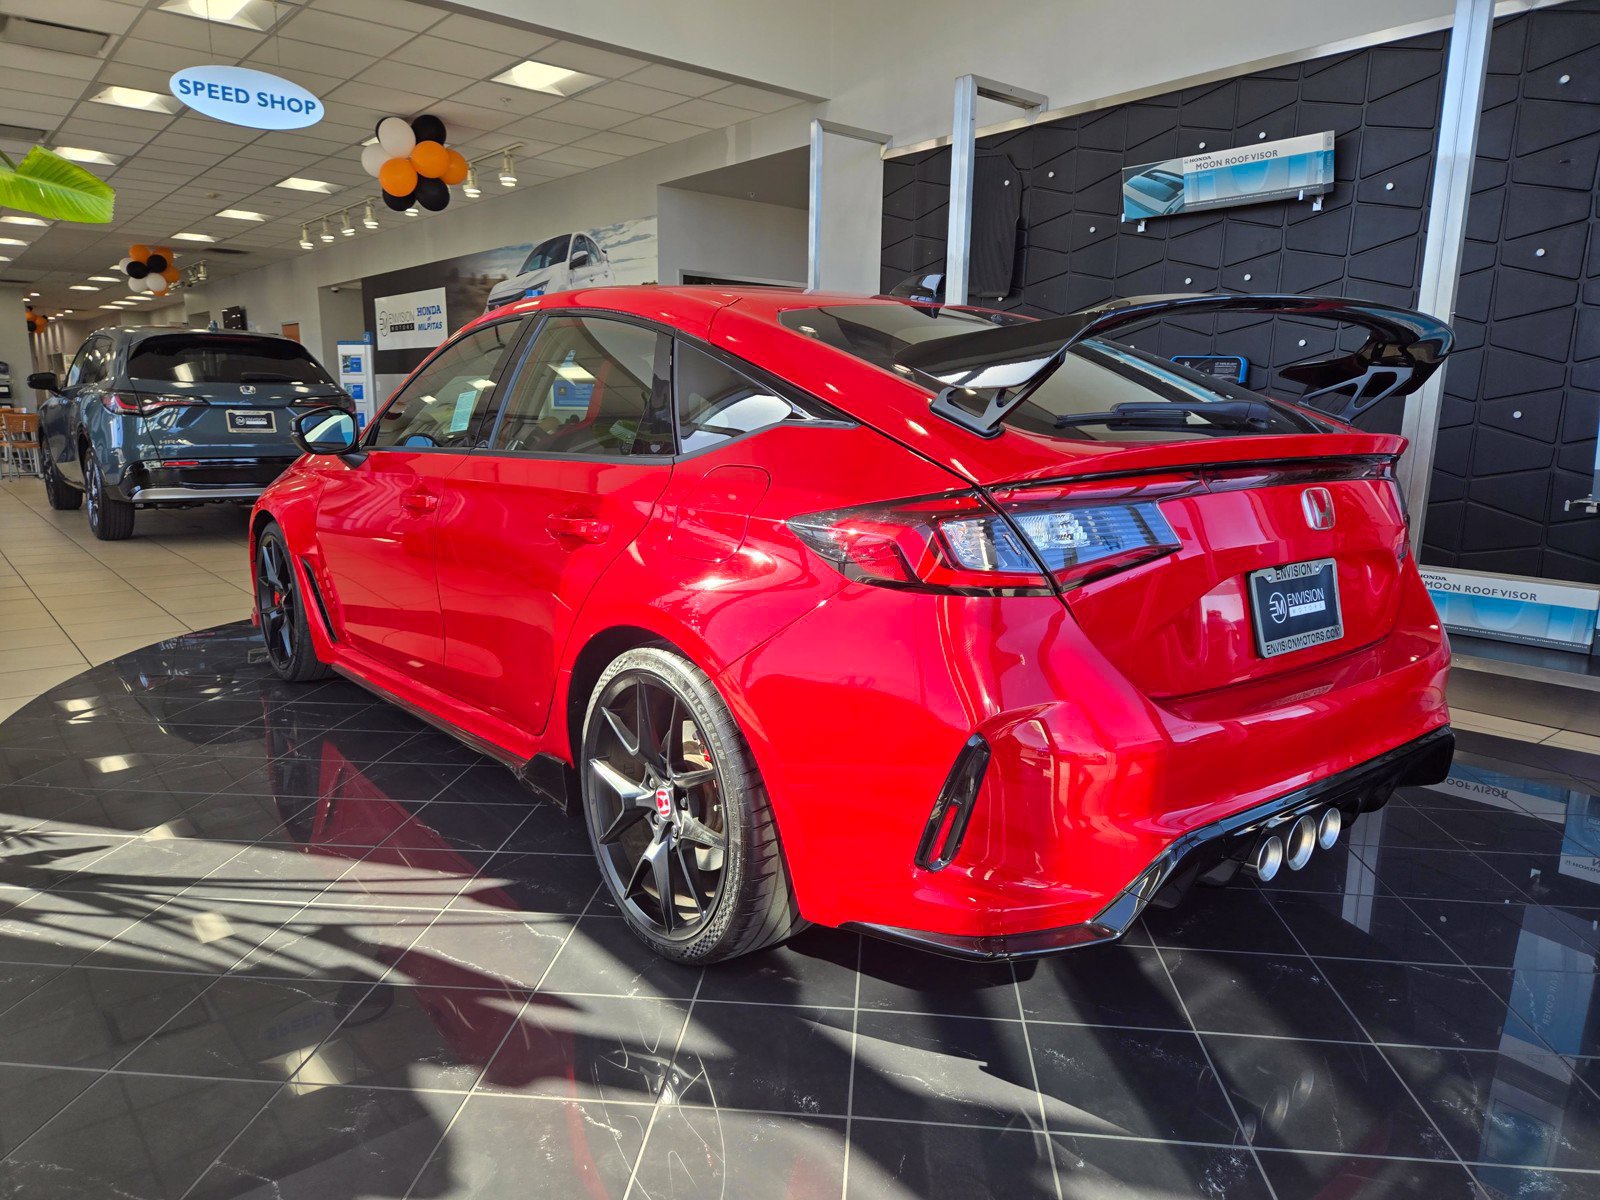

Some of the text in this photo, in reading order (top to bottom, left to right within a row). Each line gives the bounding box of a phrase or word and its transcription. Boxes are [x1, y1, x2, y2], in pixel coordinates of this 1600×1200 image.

[178, 78, 317, 115] SPEED SHOP
[1189, 155, 1212, 163] HONDA
[1195, 149, 1279, 170] MOON ROOF VISOR
[416, 304, 442, 317] HONDA
[417, 321, 443, 331] MILPITAS
[1275, 562, 1313, 580] ENVISION
[1286, 587, 1325, 607] ENVISION
[1423, 579, 1538, 601] MOON ROOF VISOR
[1292, 602, 1324, 614] MOTORS
[685, 687, 727, 760] MICHELIN
